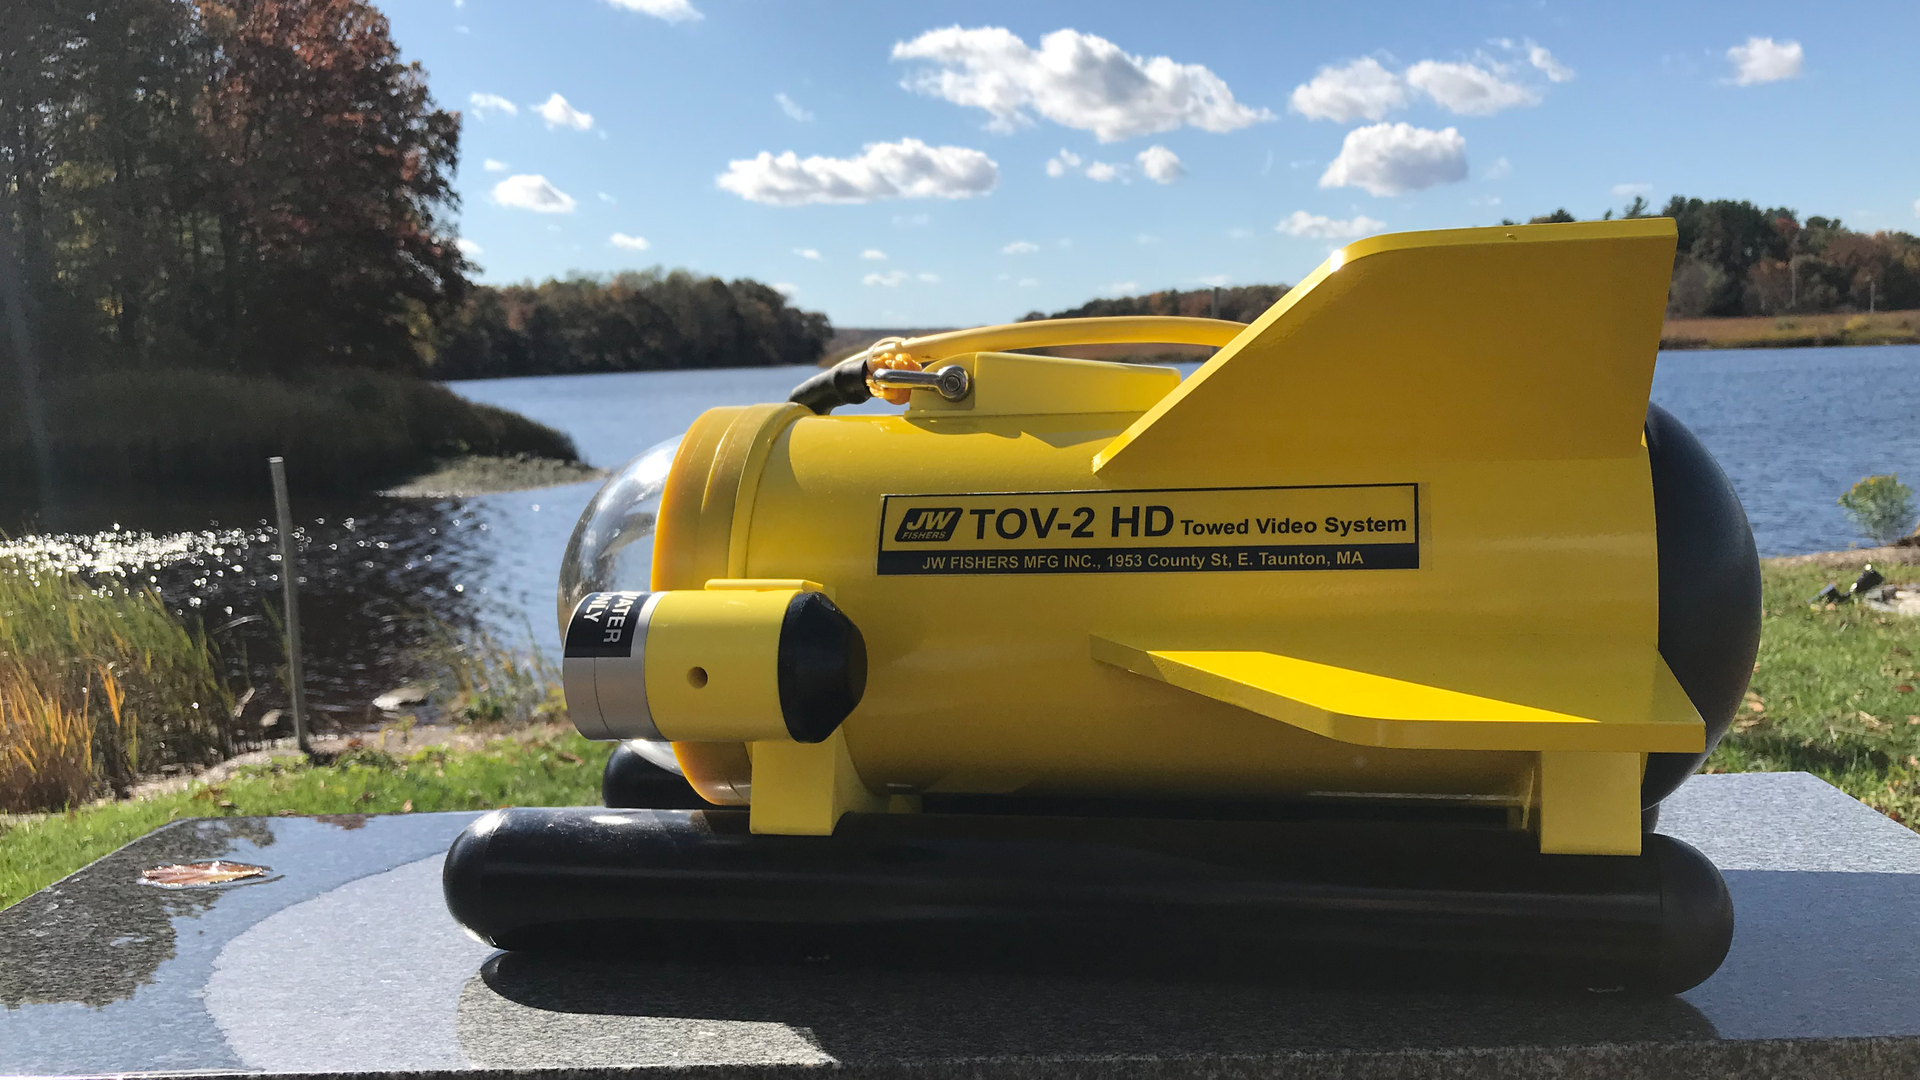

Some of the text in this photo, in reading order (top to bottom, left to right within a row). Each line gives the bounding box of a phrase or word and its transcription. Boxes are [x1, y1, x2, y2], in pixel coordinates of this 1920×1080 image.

[906, 511, 955, 530] JW
[969, 505, 1406, 539] TOV-2 HD Towed Video System
[901, 531, 946, 540] FISHERS
[922, 551, 1364, 570] JW FISHERS MFG INC., 1953 County St, E. Taunton, MA
